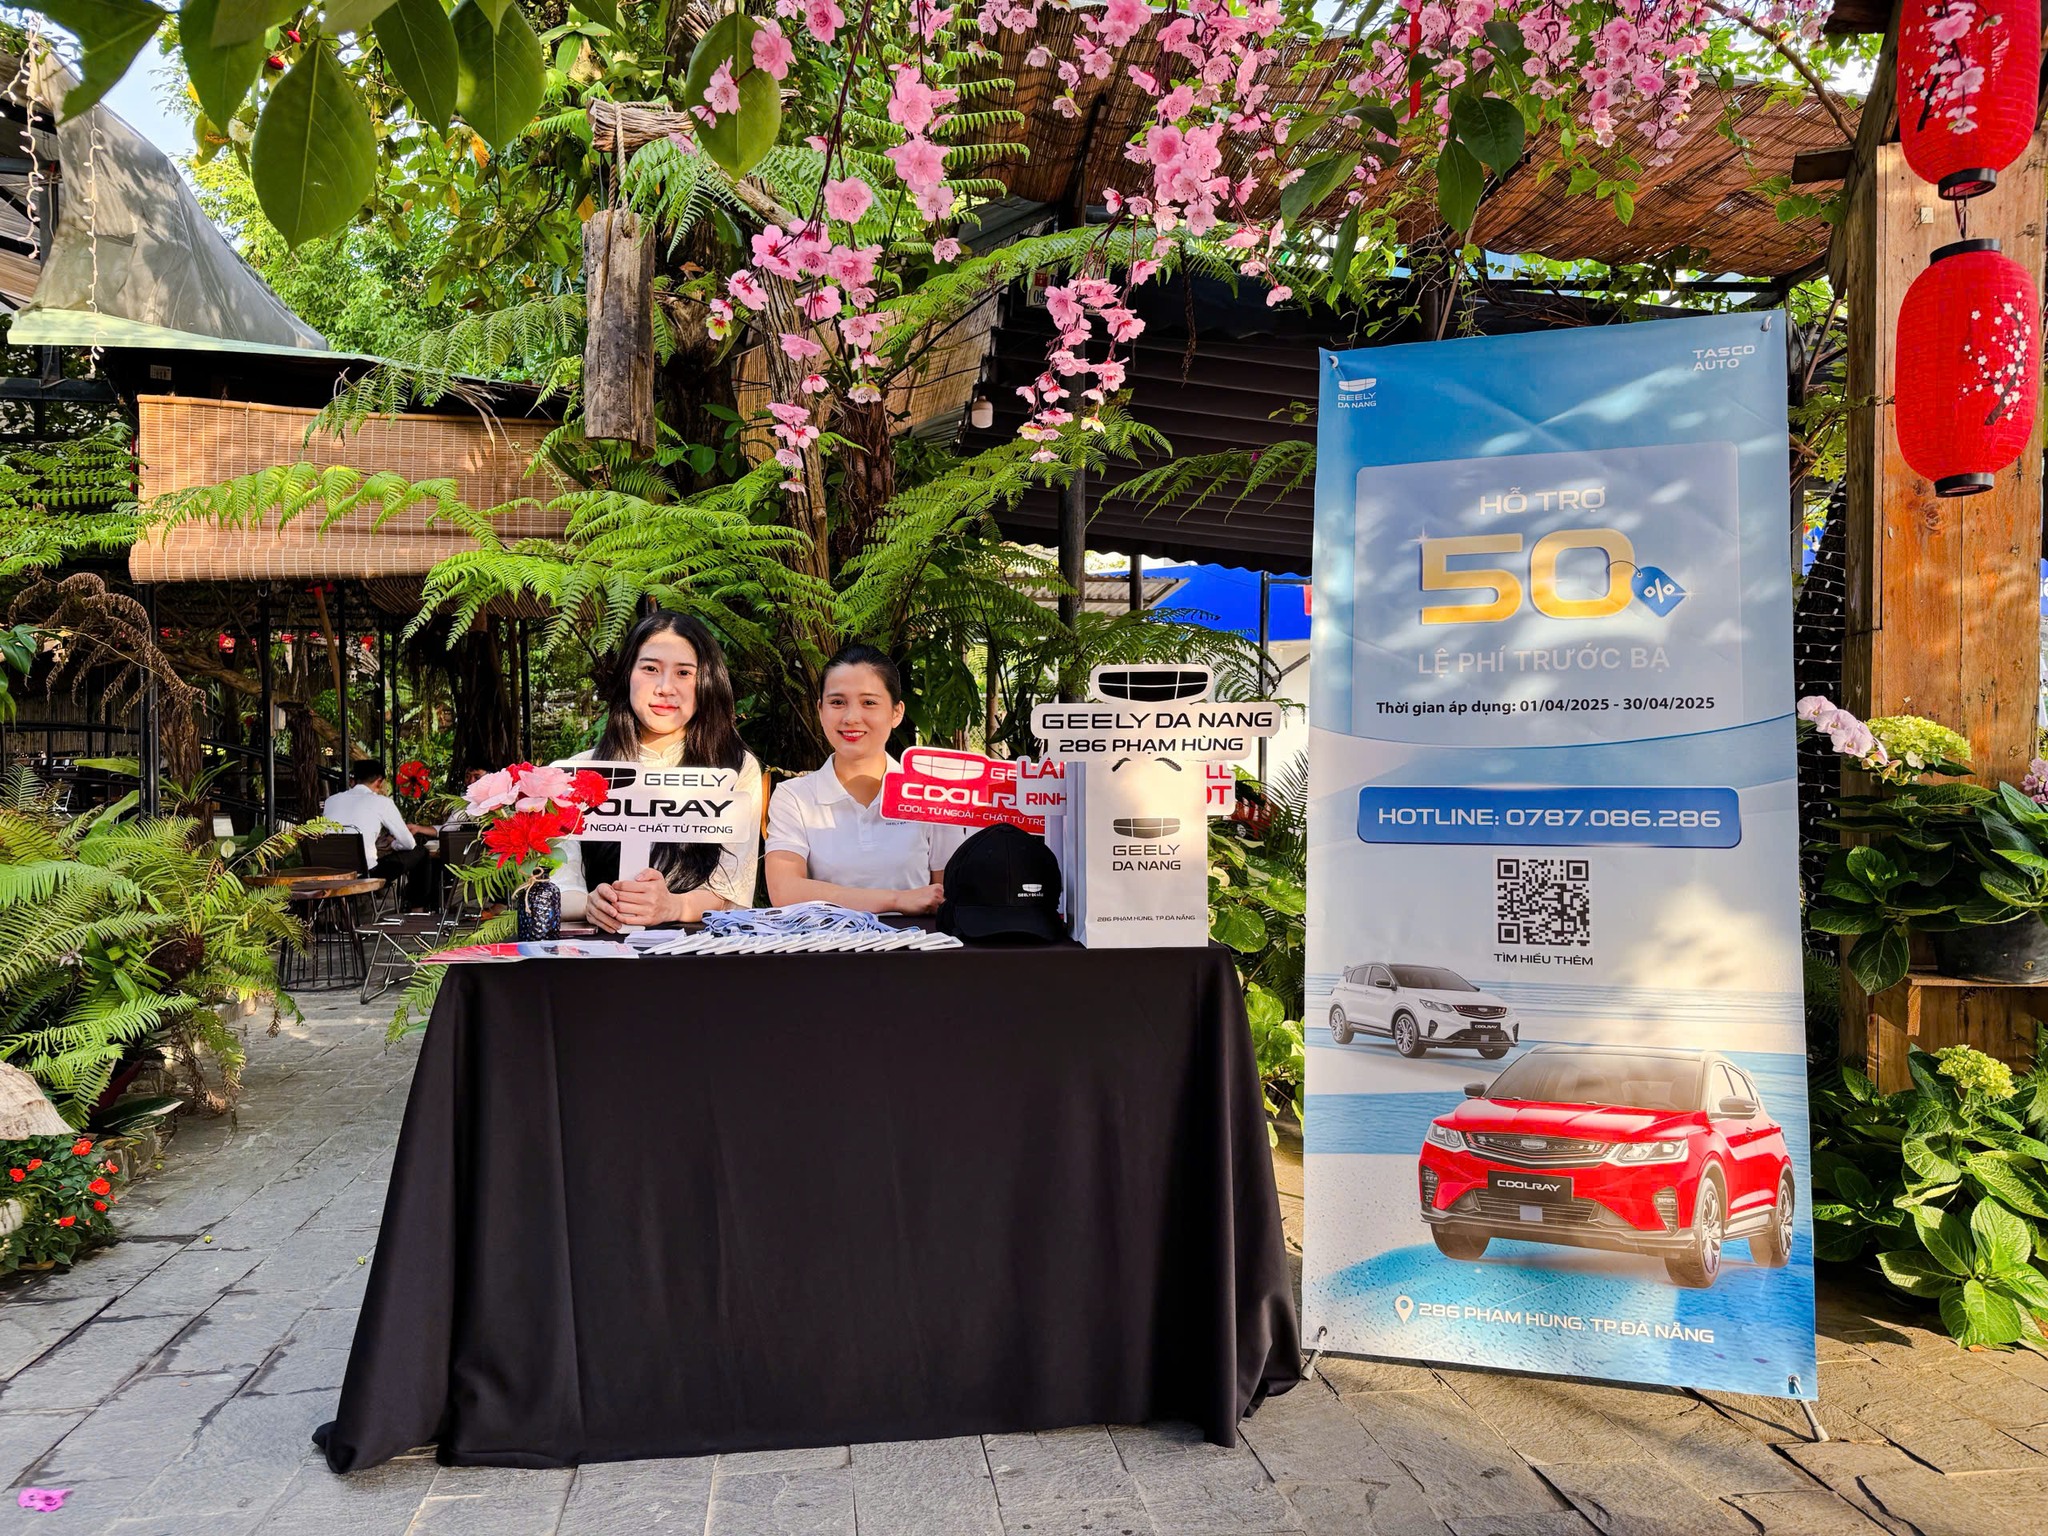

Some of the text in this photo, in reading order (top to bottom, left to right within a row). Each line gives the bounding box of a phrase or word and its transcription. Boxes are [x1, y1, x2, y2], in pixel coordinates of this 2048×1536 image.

[1692, 345, 1755, 359] TASCO
[1693, 358, 1740, 371] AUTO
[1338, 392, 1376, 401] GEELY
[1351, 400, 1377, 408] NANG
[1480, 486, 1605, 515] HỖ TRỢ
[1421, 528, 1635, 625] 50
[1418, 641, 1670, 680] LỆ PHÍ TRƯỚC BẠ
[1376, 701, 1409, 714] Thời
[1412, 702, 1445, 717] gian
[1449, 700, 1468, 716] áp
[1471, 700, 1516, 716] dụng:
[1520, 698, 1610, 712] 01/04/2025
[1623, 696, 1715, 711] 30/04/2025
[1042, 711, 1273, 730] GEELY DA NANG
[1059, 735, 1244, 755] 286 PHẠM HÙNG
[644, 773, 728, 788] GEELY
[584, 798, 734, 818] OLRAY
[897, 803, 925, 814] COOL
[943, 808, 974, 819] NGOÀI
[1378, 808, 1721, 829] HOTLINE: 0787.086.286
[590, 823, 627, 832] NGOÀI
[638, 823, 670, 833] CHẤT
[672, 823, 690, 834] TỪ
[692, 825, 733, 834] TRONG
[1112, 844, 1181, 856] GEELY
[1112, 860, 1181, 871] DA NANG
[1493, 951, 1517, 963] TÌM
[1554, 954, 1593, 966] THÊM
[1497, 1179, 1561, 1193] COOLRAY
[1419, 1302, 1461, 1317] 286
